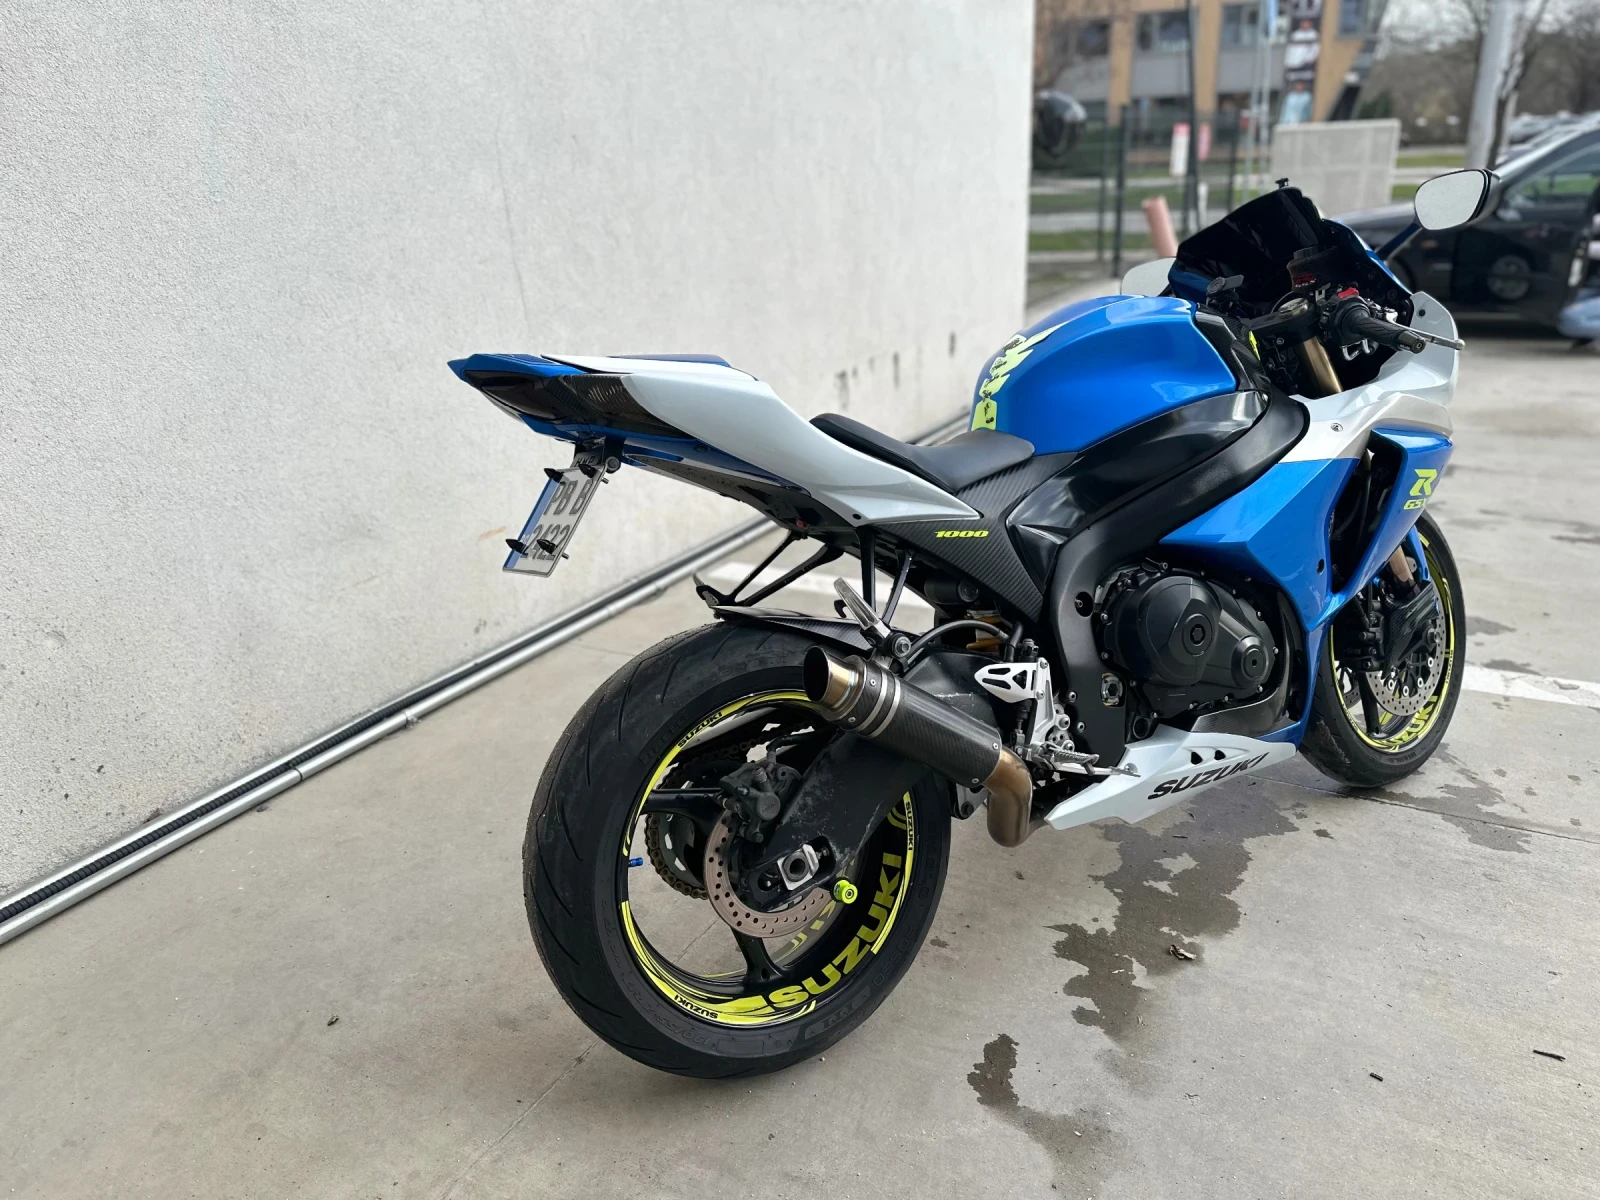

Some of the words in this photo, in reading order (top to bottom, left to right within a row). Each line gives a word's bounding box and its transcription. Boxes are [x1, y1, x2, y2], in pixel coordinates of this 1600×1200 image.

[543, 480, 578, 516] PB
[1409, 468, 1438, 496] R
[520, 524, 571, 560] 2422
[935, 530, 989, 538] 1000
[677, 711, 722, 747] SUZUKI
[1147, 751, 1270, 799] SUZUKI
[905, 801, 914, 850] SUZUKI
[769, 852, 903, 1008] SUZUKI
[674, 994, 718, 1019] SUZUKI
